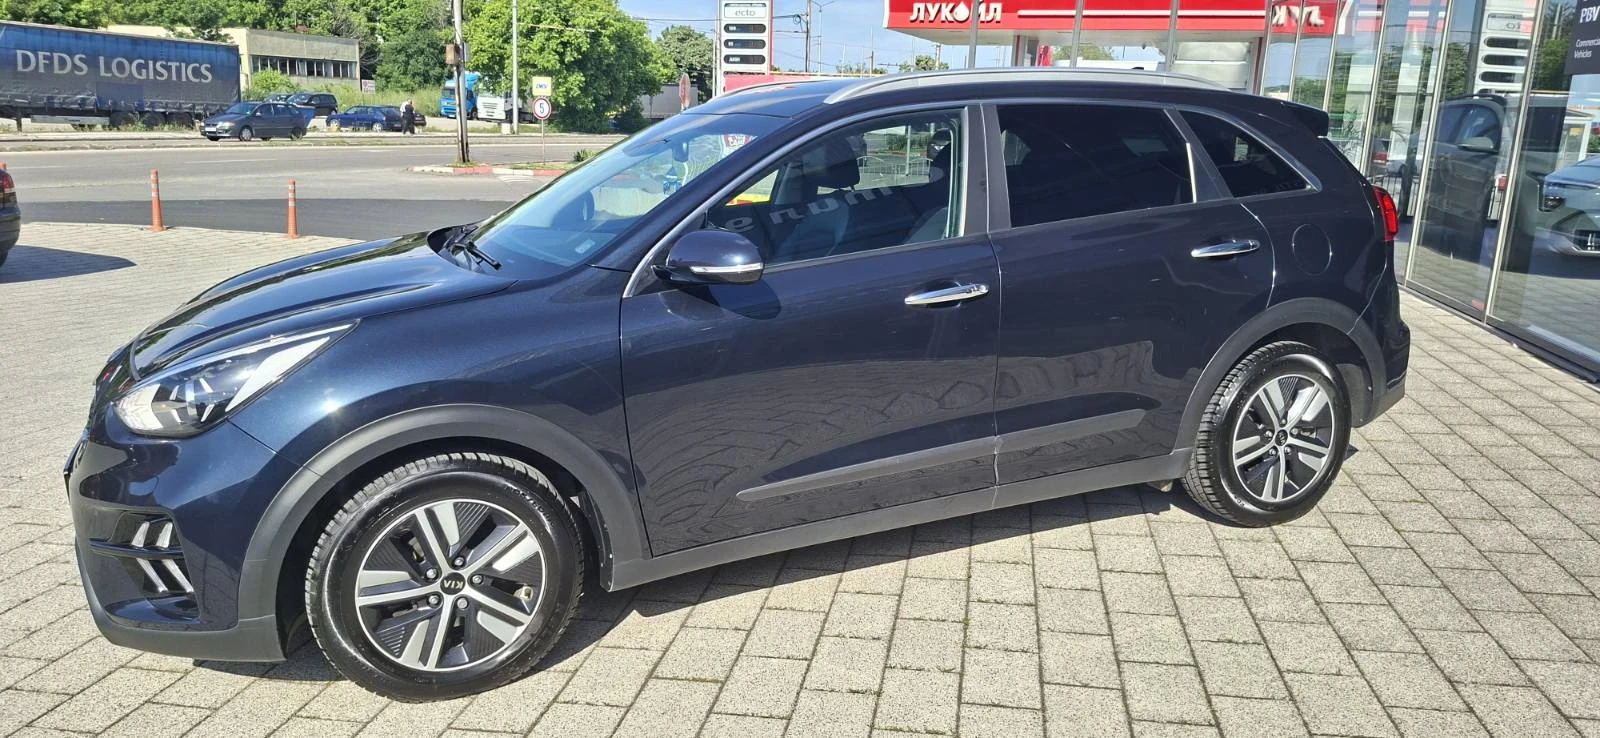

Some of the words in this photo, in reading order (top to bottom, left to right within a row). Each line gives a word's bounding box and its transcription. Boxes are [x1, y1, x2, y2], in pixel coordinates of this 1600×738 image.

[735, 9, 756, 17] ecto
[1575, 38, 1600, 48] Commercia
[1574, 49, 1593, 59] Vehicles
[16, 50, 88, 75] DFDS
[99, 56, 213, 83] LOGISTICS
[539, 102, 545, 114] 5
[443, 579, 464, 589] KIA
